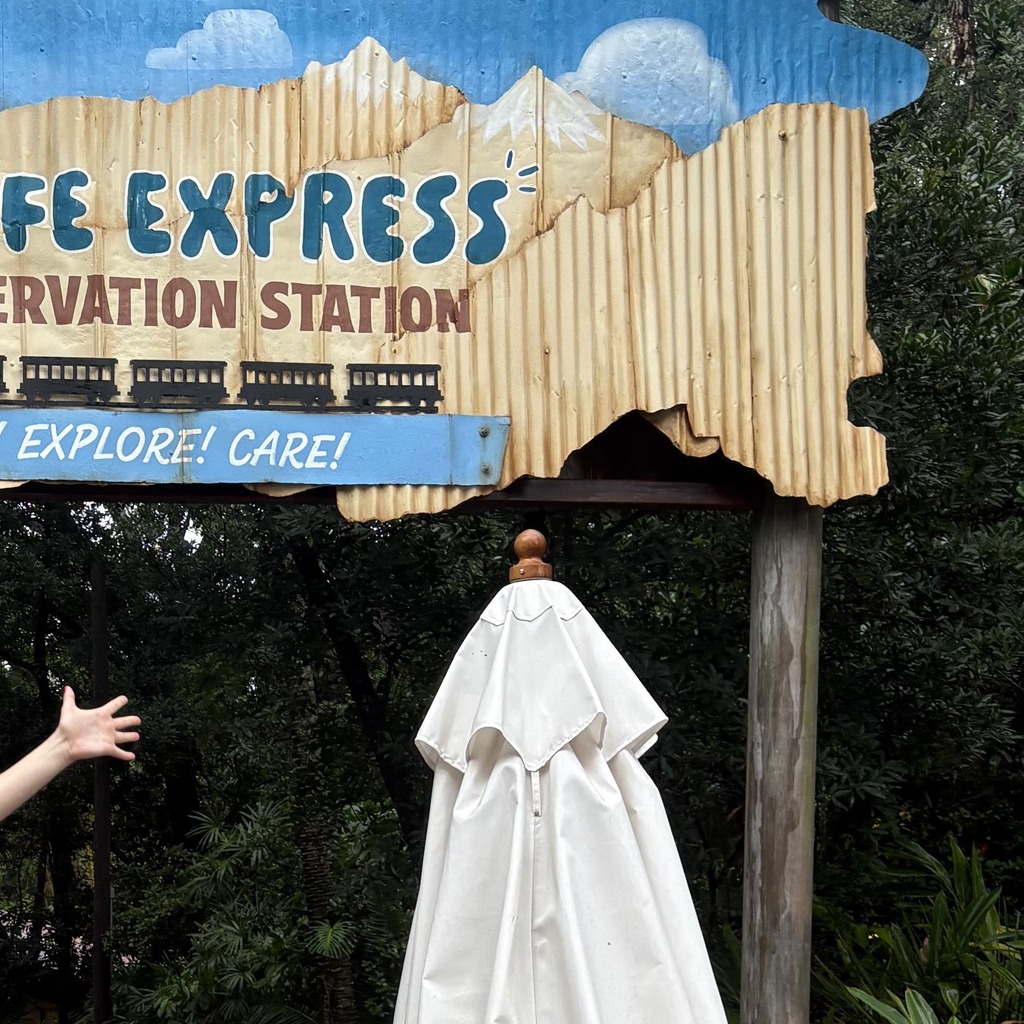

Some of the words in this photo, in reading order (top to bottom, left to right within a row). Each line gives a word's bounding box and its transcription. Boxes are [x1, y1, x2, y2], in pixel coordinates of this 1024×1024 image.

[126, 170, 508, 265] EXPRESS
[260, 281, 471, 333] STATION
[17, 423, 217, 465] EXPLORE!
[228, 428, 351, 470] CARE!
